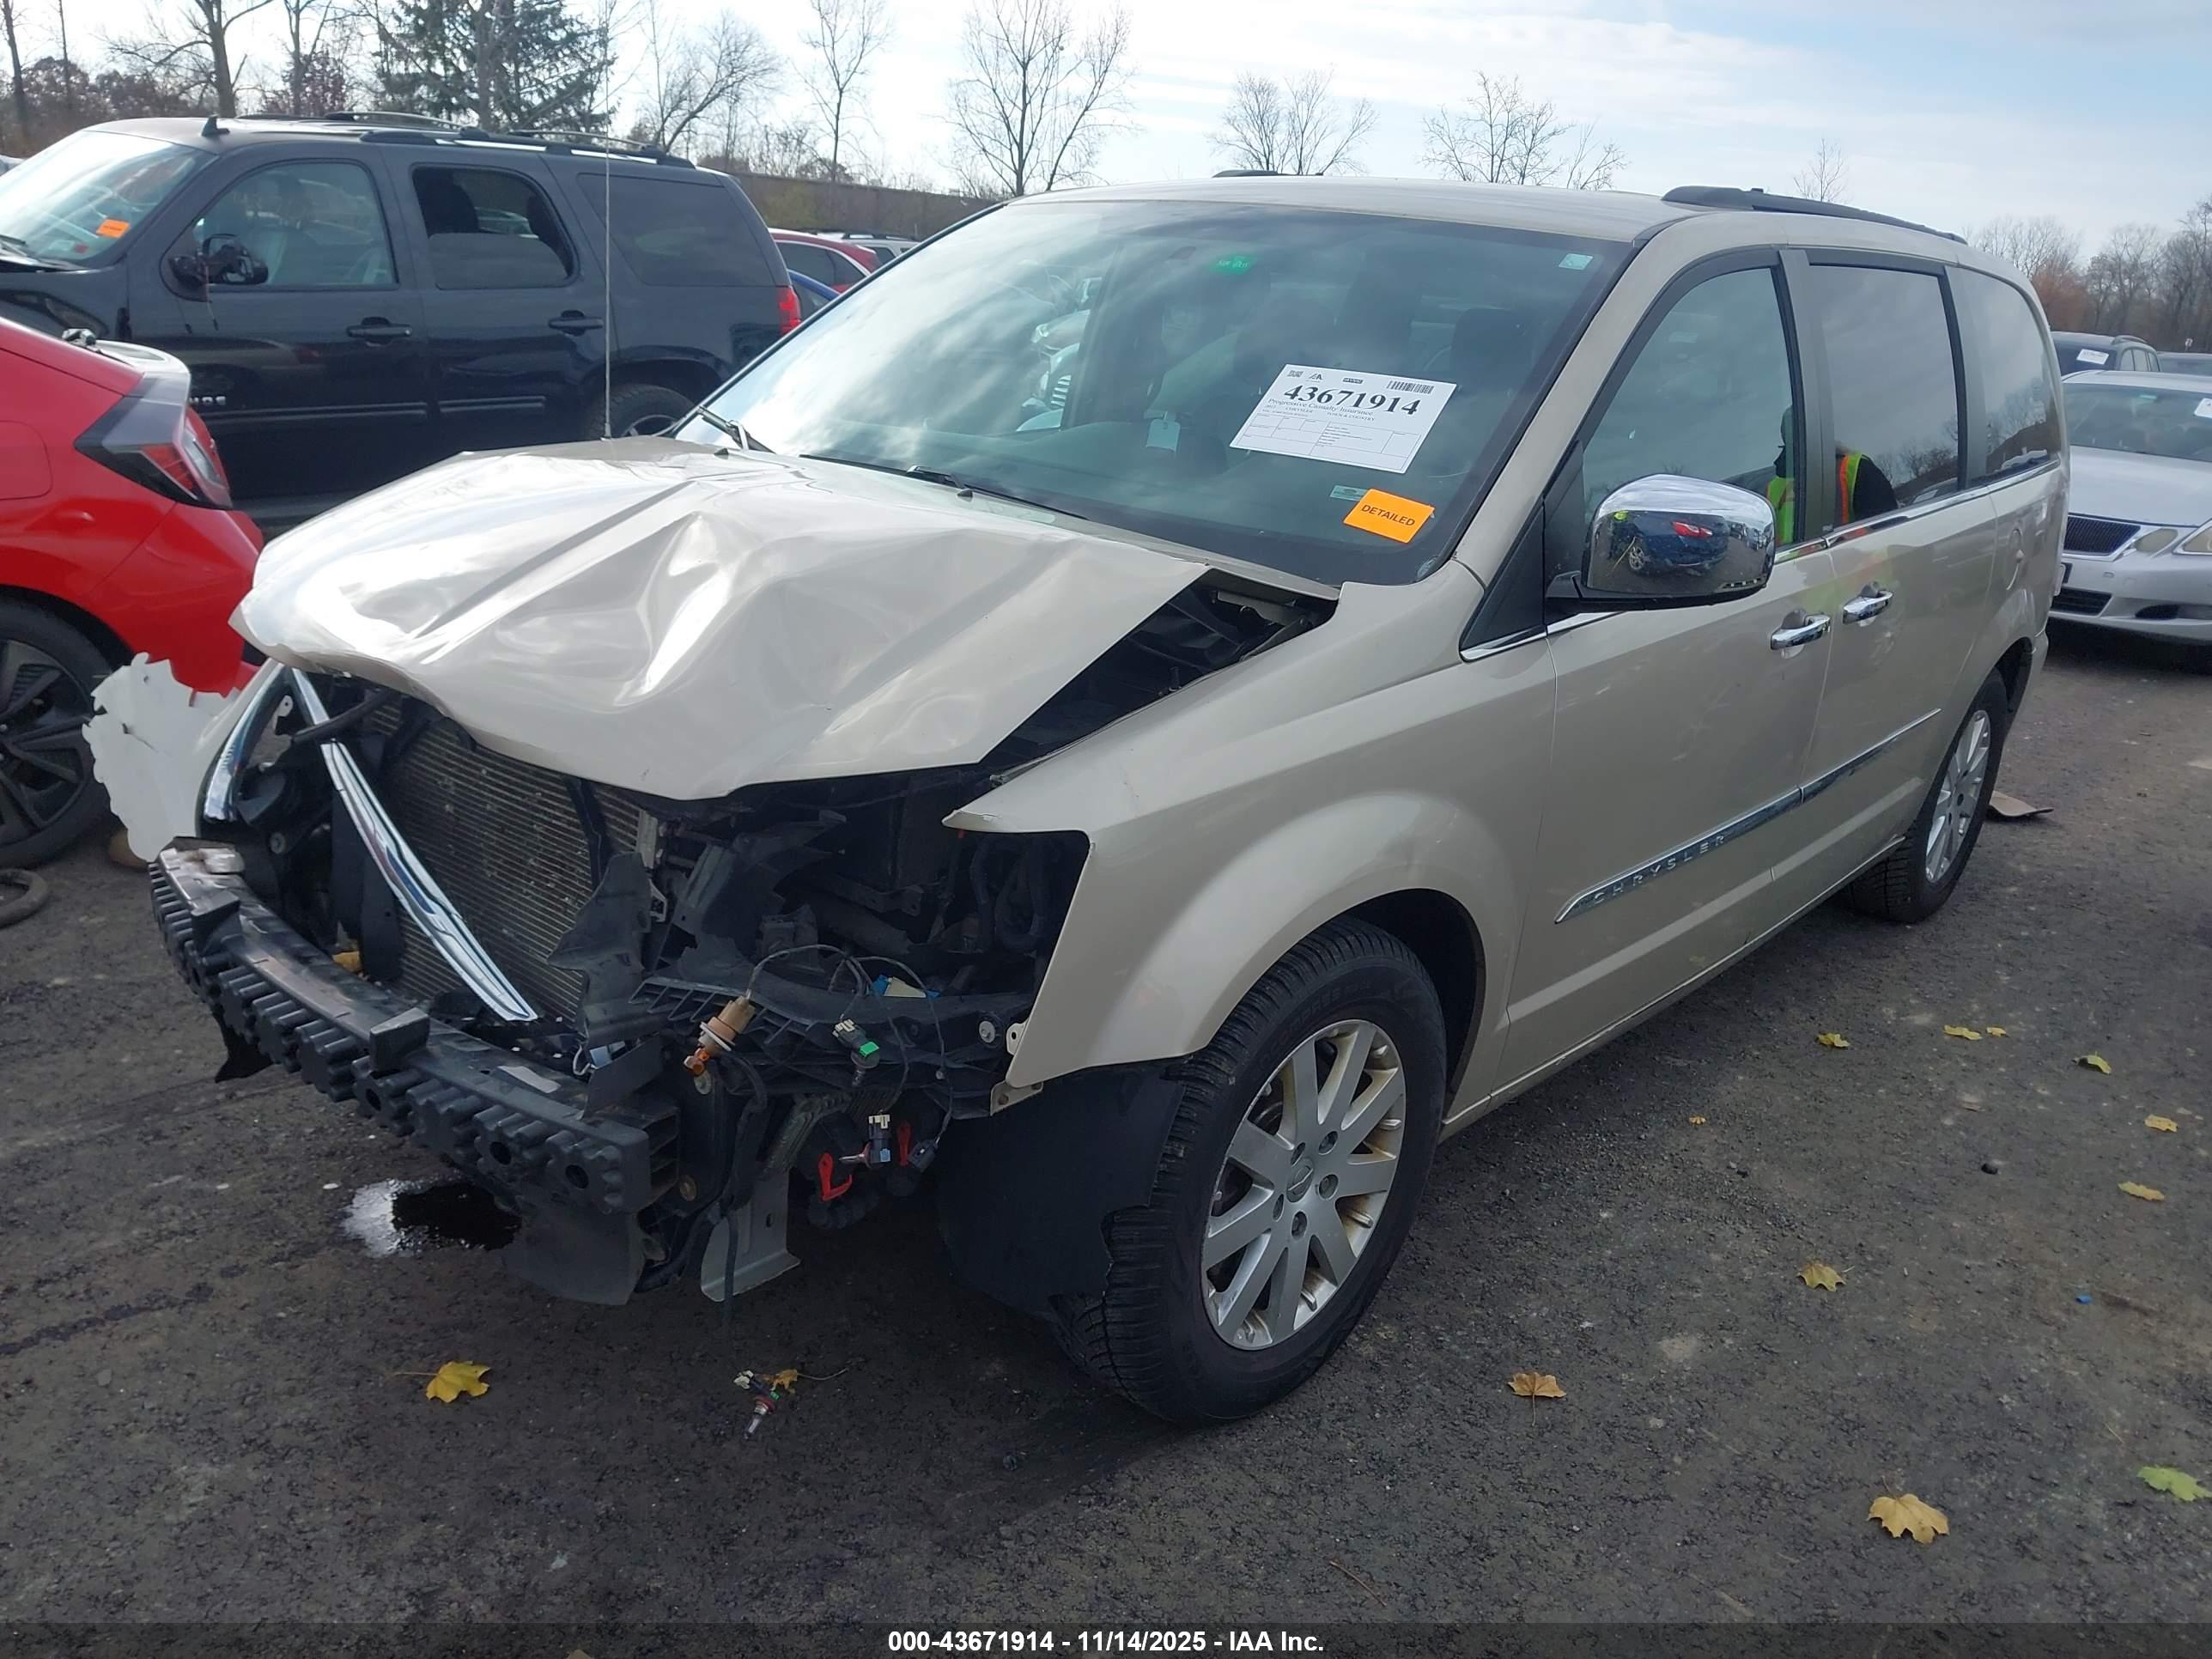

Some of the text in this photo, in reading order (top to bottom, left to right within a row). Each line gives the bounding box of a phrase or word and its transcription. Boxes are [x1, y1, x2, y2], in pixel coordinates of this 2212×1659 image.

[1267, 398, 1374, 416] Progressive Casualty Insurance
[1284, 385, 1421, 415] 43671914
[1361, 504, 1416, 526] DETAILED
[1593, 835, 1725, 904] CHRYSLER
